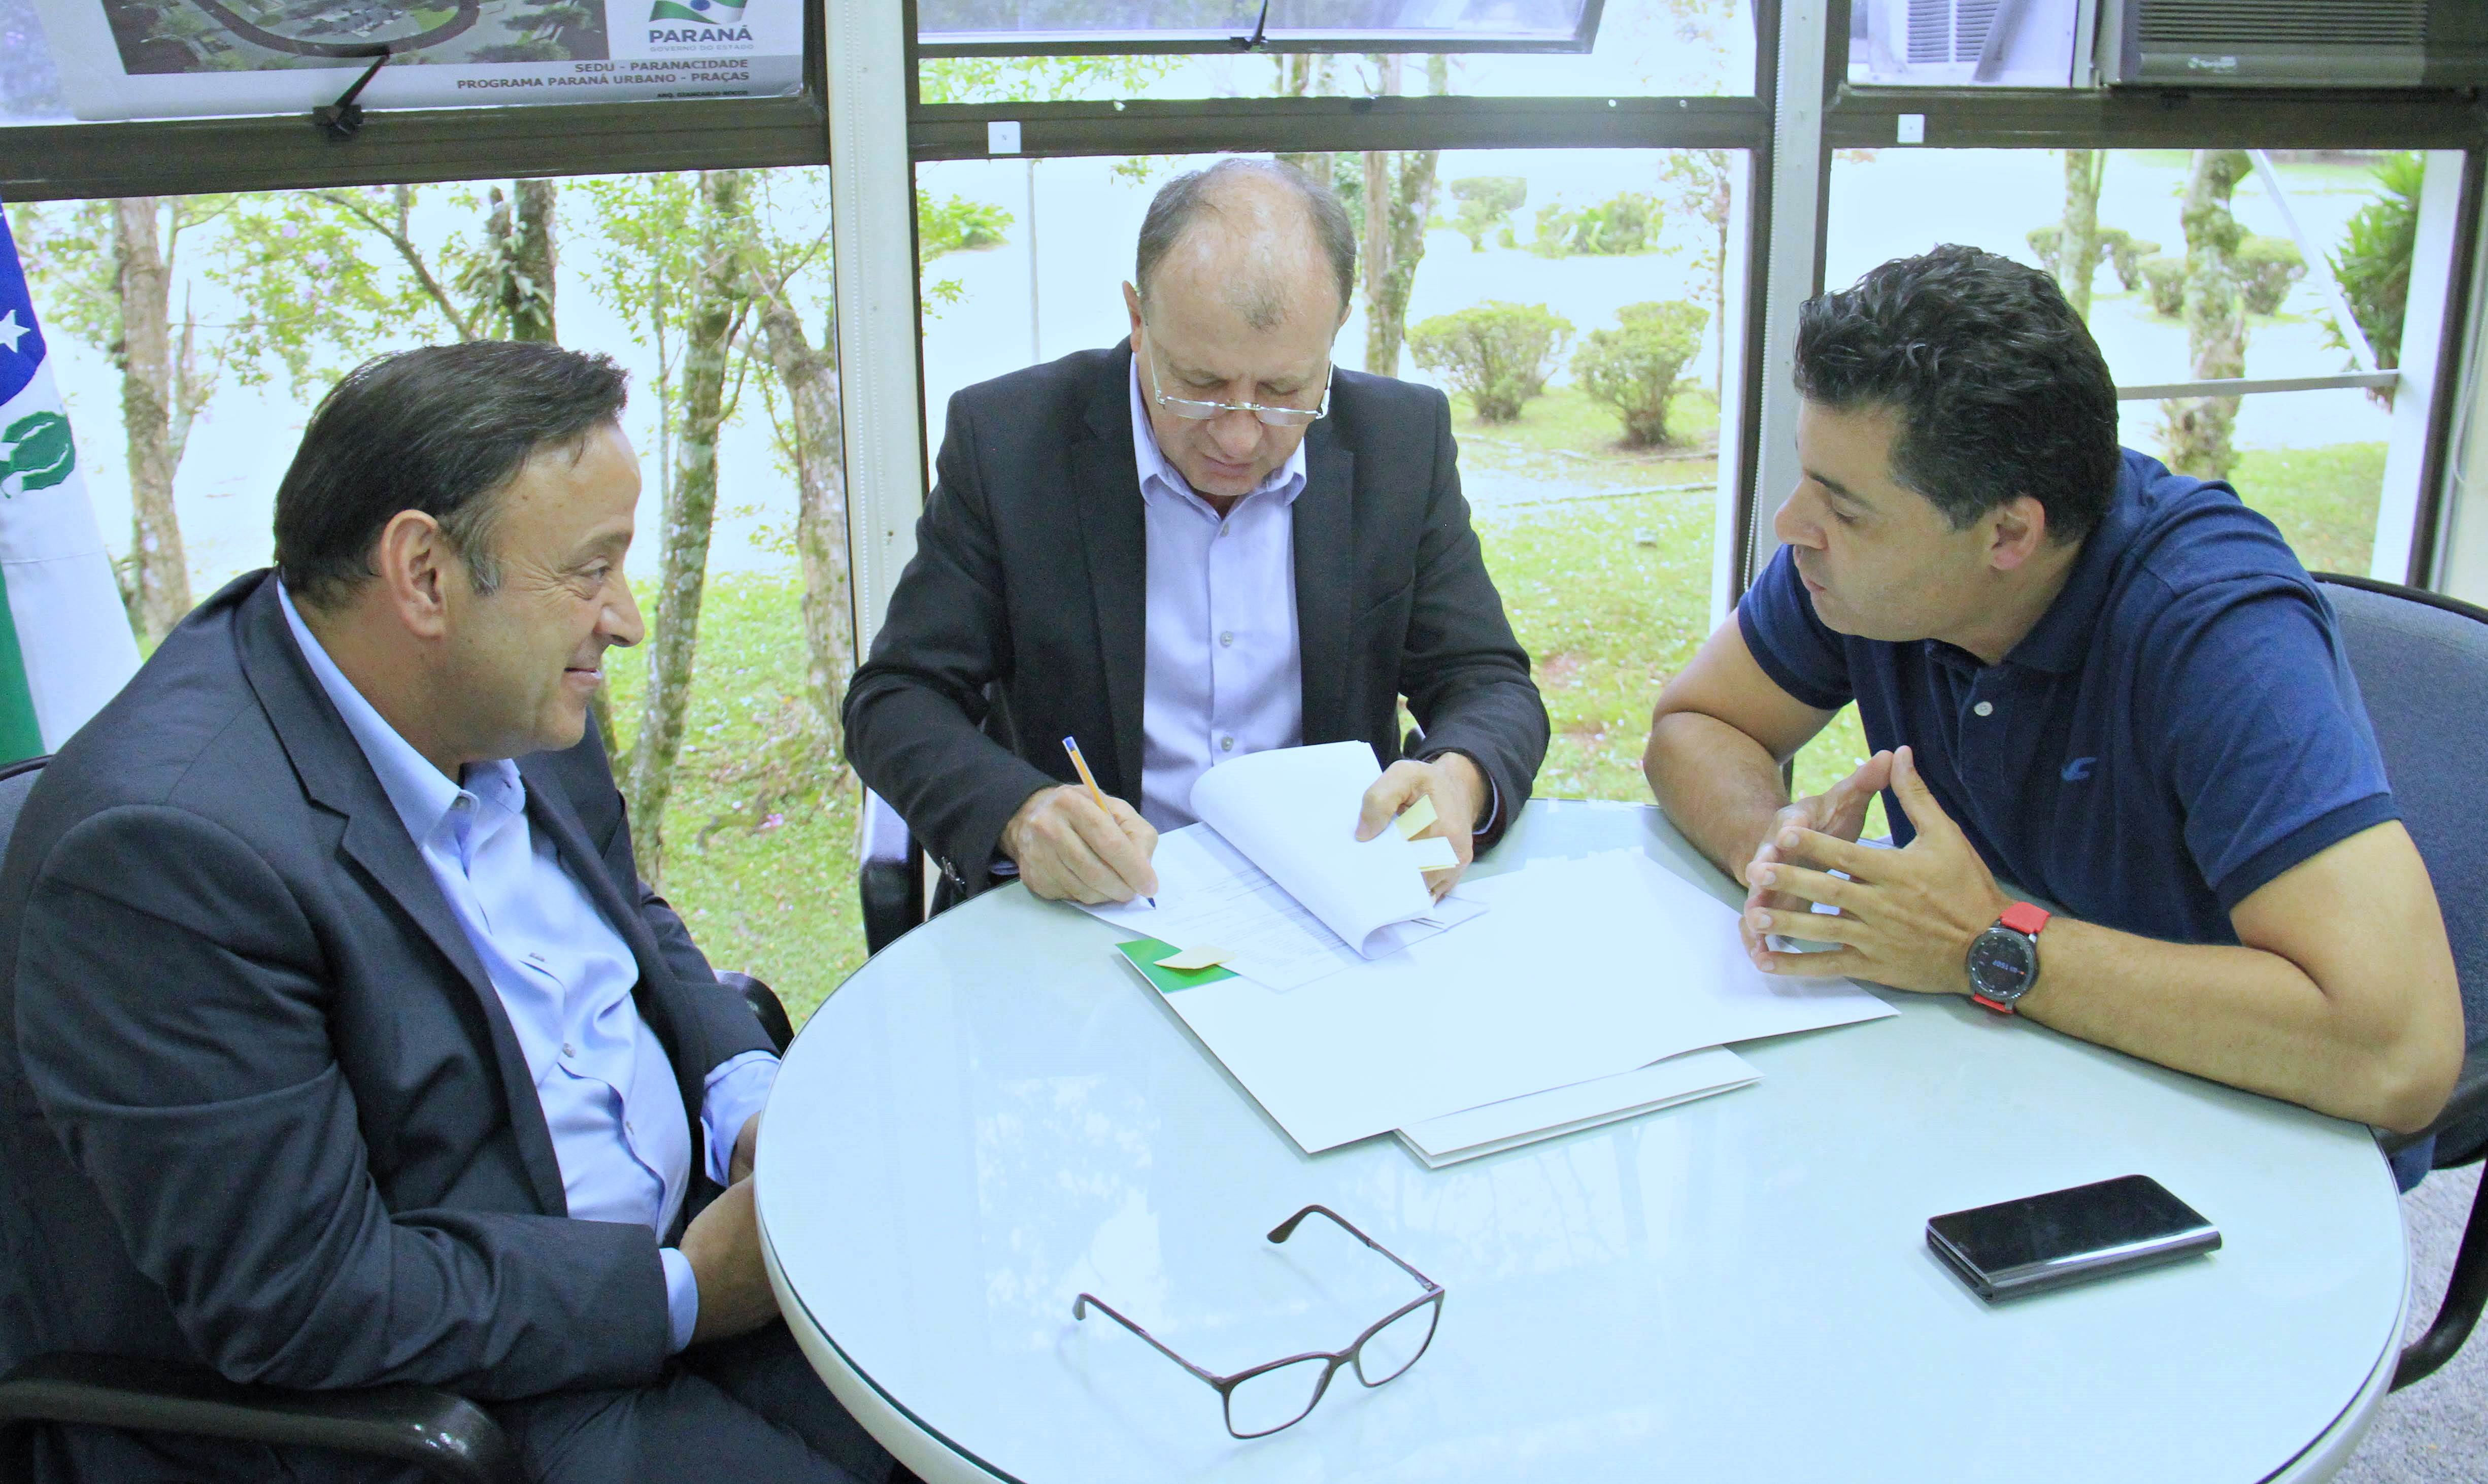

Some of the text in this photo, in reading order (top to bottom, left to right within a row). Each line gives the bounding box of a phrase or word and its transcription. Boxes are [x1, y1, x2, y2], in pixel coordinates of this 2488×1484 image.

[649, 25, 753, 43] PARANÁ
[575, 63, 615, 72] SEDU
[630, 59, 748, 70] PARANACIDADE
[457, 78, 543, 89] PROGRAMA
[548, 73, 609, 86] PARANÁ
[613, 74, 676, 84] URBANO
[691, 72, 749, 82] PRAÇAS
